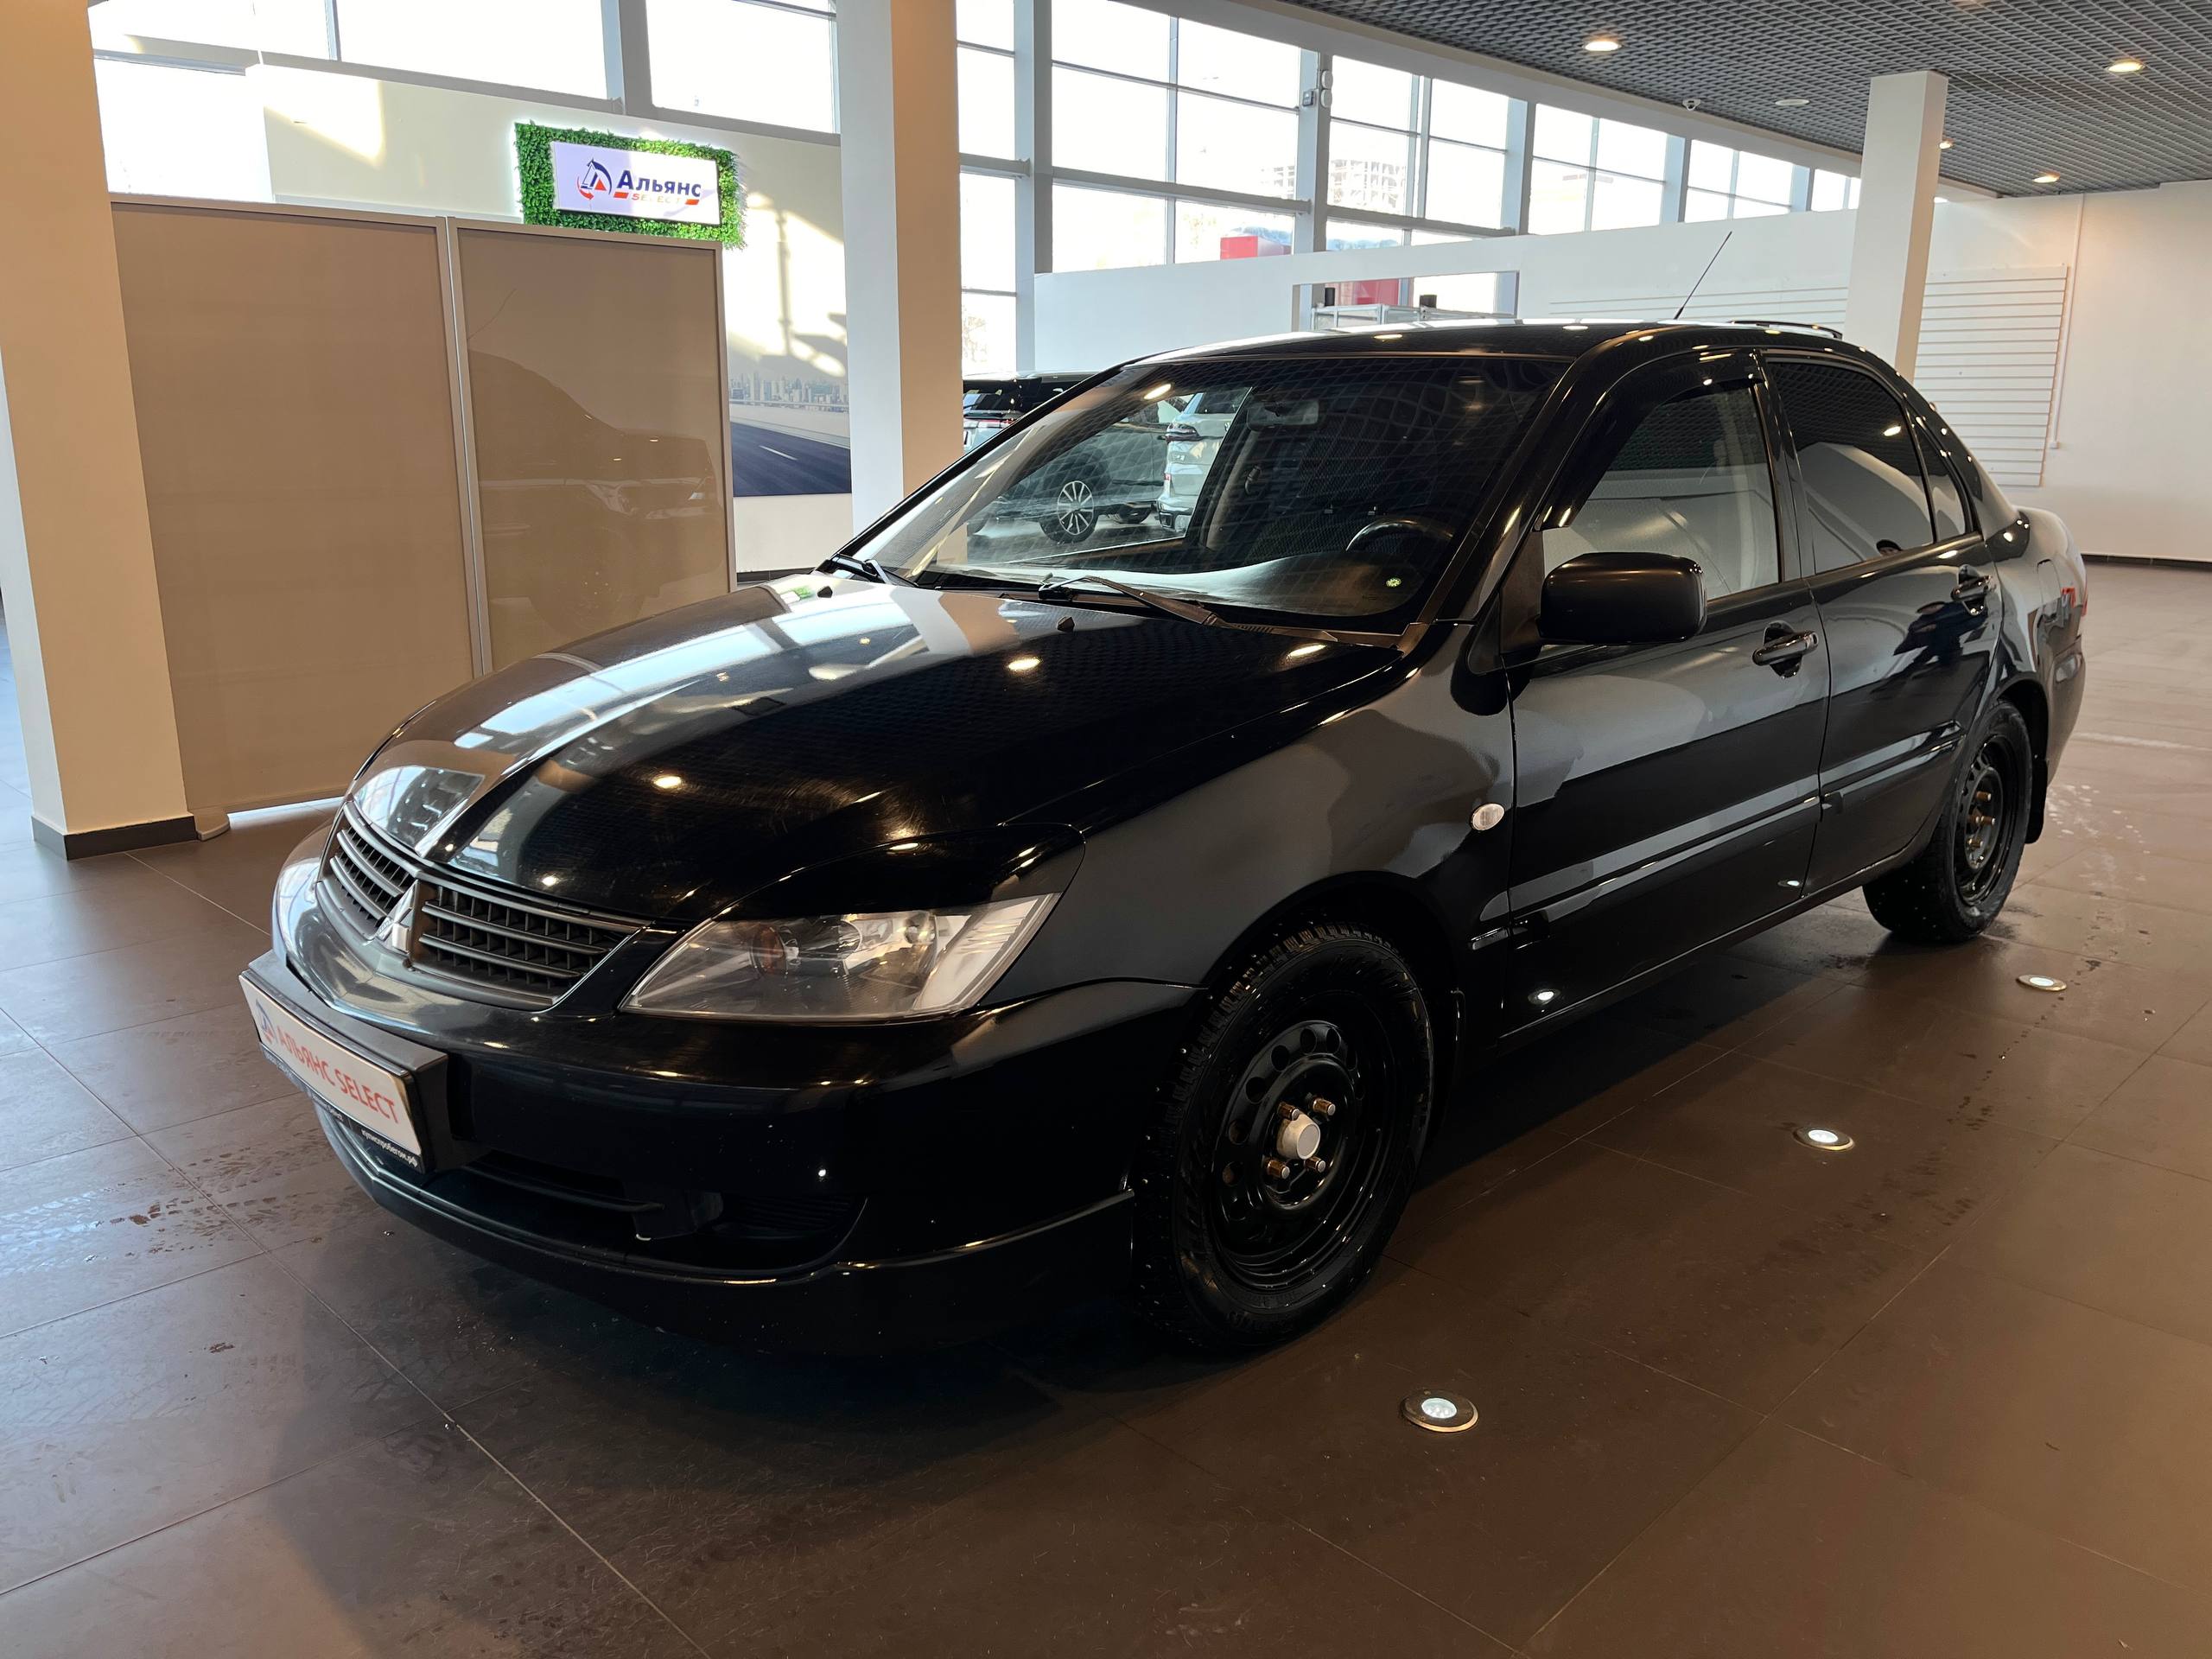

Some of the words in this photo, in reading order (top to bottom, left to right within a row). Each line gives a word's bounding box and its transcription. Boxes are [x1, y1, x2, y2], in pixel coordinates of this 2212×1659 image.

[616, 169, 702, 197] Альянс
[276, 1026, 335, 1086] АЛЬЯНС
[334, 1068, 399, 1123] SELECT
